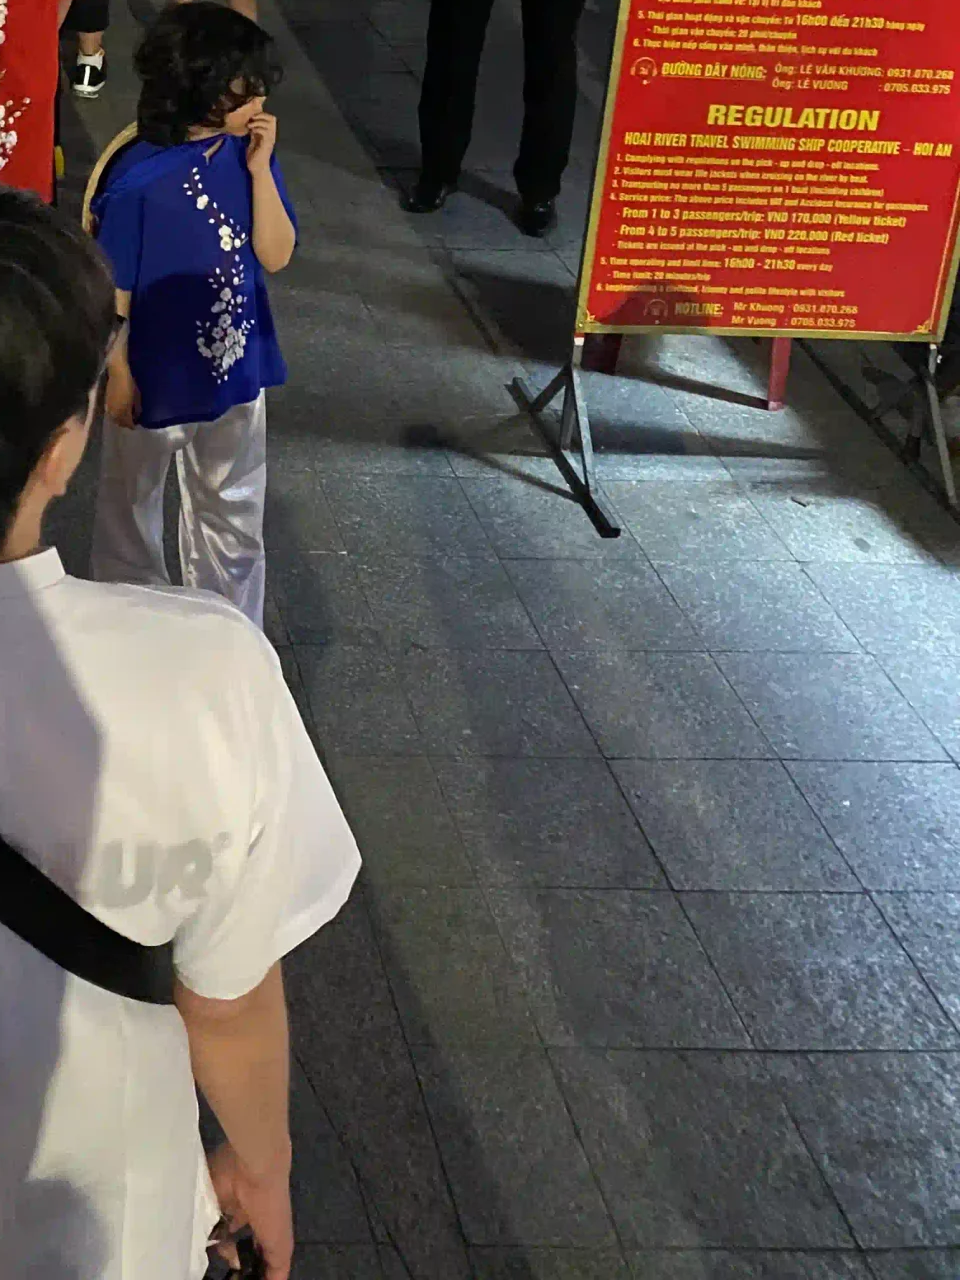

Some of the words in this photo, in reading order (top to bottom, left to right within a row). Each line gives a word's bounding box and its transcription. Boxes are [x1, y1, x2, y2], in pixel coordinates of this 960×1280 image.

[707, 104, 879, 130] REGULATION
[624, 131, 651, 145] HOAI
[653, 133, 687, 146] RIVER
[689, 134, 730, 148] TRAVEL
[732, 135, 796, 150] SWIMMING
[797, 138, 825, 151] SHIP
[827, 139, 901, 154] COOPERATIVE
[912, 142, 934, 155] HOI
[934, 143, 952, 156] AN
[675, 302, 724, 315] HOTLINE:
